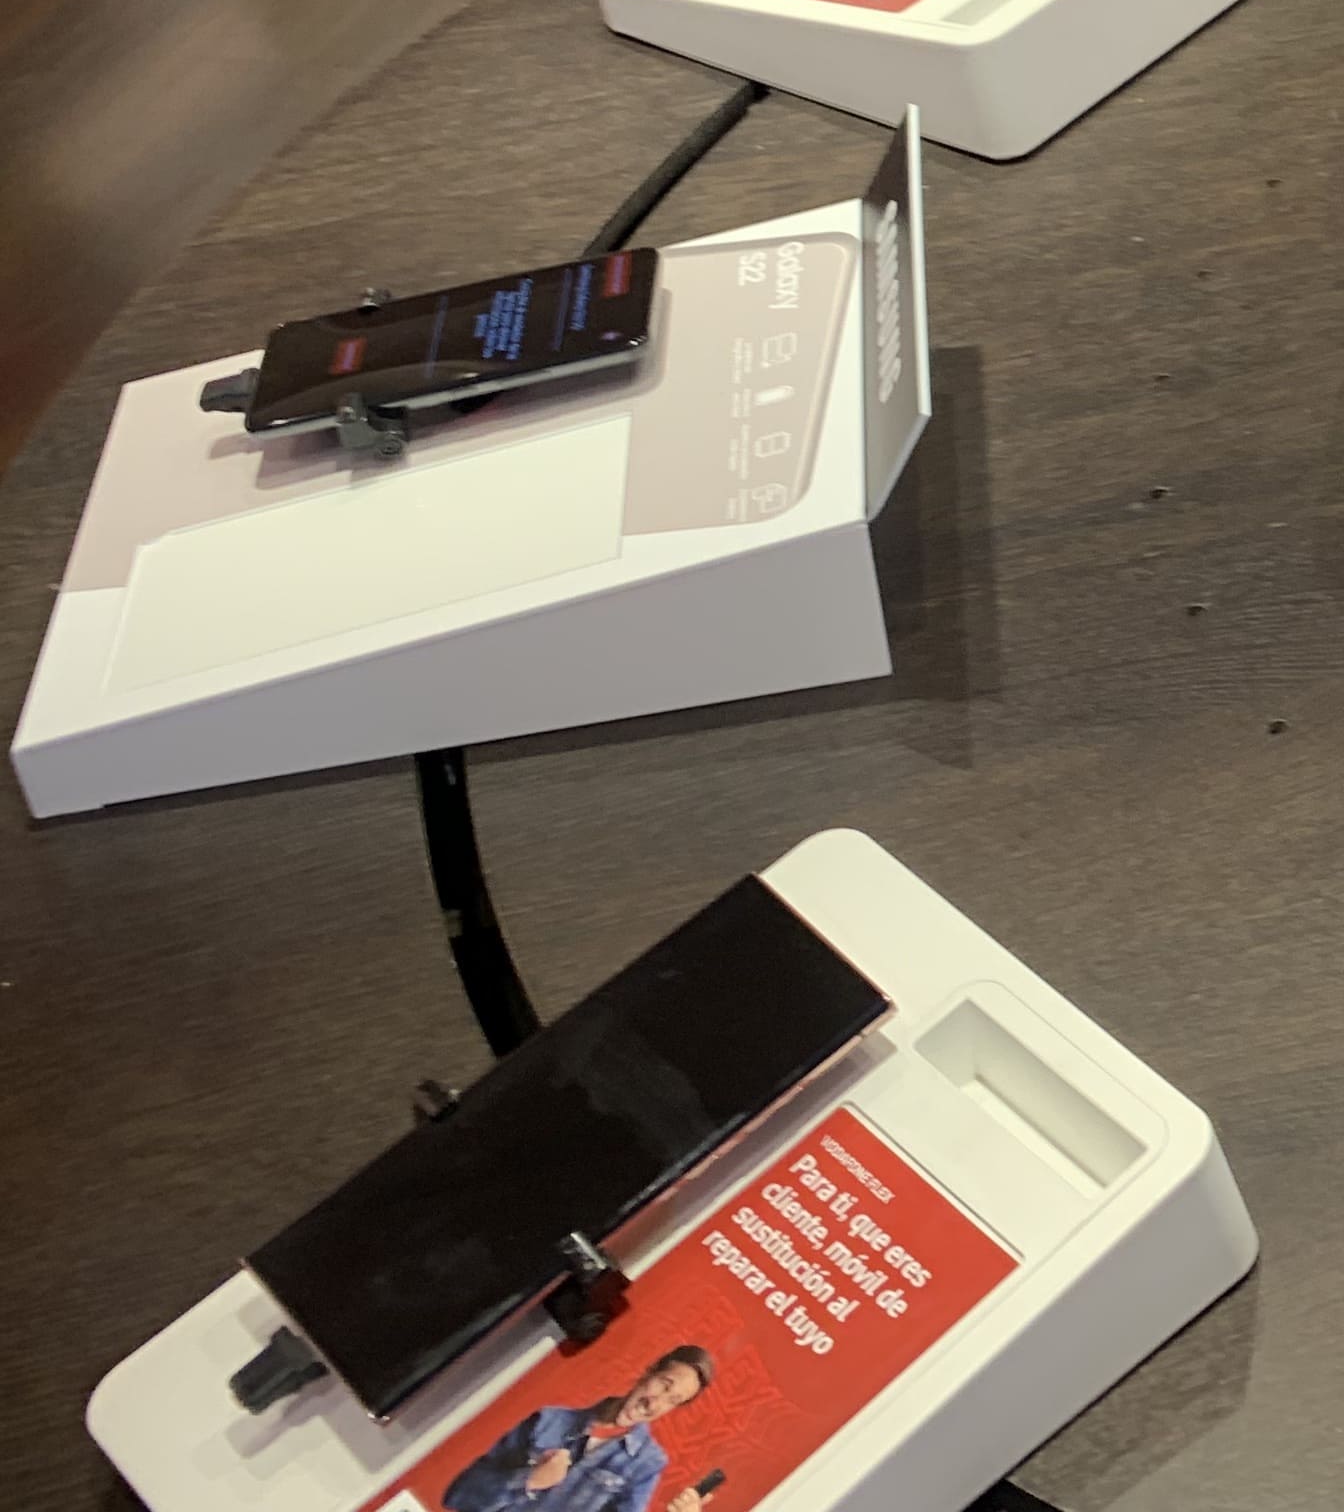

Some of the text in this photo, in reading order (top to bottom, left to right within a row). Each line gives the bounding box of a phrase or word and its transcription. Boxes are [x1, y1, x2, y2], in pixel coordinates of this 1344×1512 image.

[738, 251, 767, 286] S22
[768, 242, 804, 309] Galaxy
[731, 1207, 860, 1322] sustitución al
[761, 1183, 908, 1319] cliente, móvil de
[789, 1153, 933, 1288] Para ti, que eres
[701, 1230, 834, 1355] reparar el tuyo
